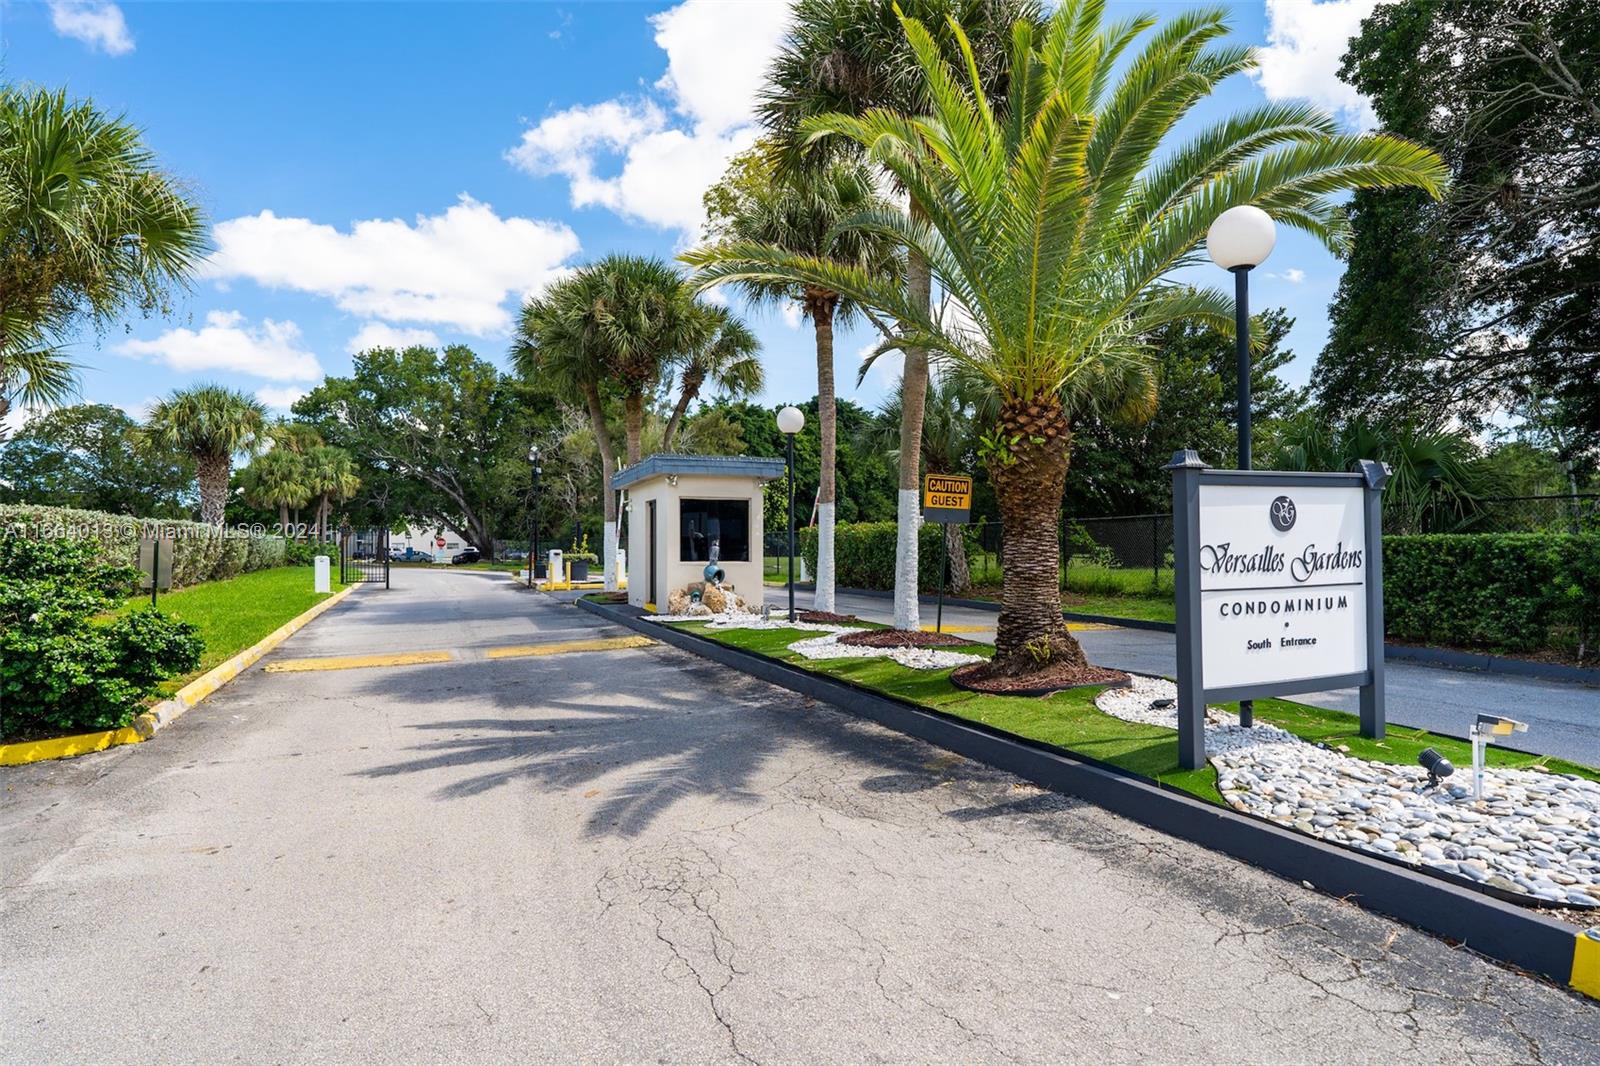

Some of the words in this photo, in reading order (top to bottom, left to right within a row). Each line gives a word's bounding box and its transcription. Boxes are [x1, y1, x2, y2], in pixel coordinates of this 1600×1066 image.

[929, 480, 968, 493] CAUTION
[931, 495, 964, 507] GUEST
[1199, 542, 1285, 574] Versailles
[1290, 541, 1363, 582] Gardens
[1220, 596, 1348, 616] CONDOMINIUM
[1247, 638, 1272, 650] South
[1280, 636, 1317, 648] Entrance
